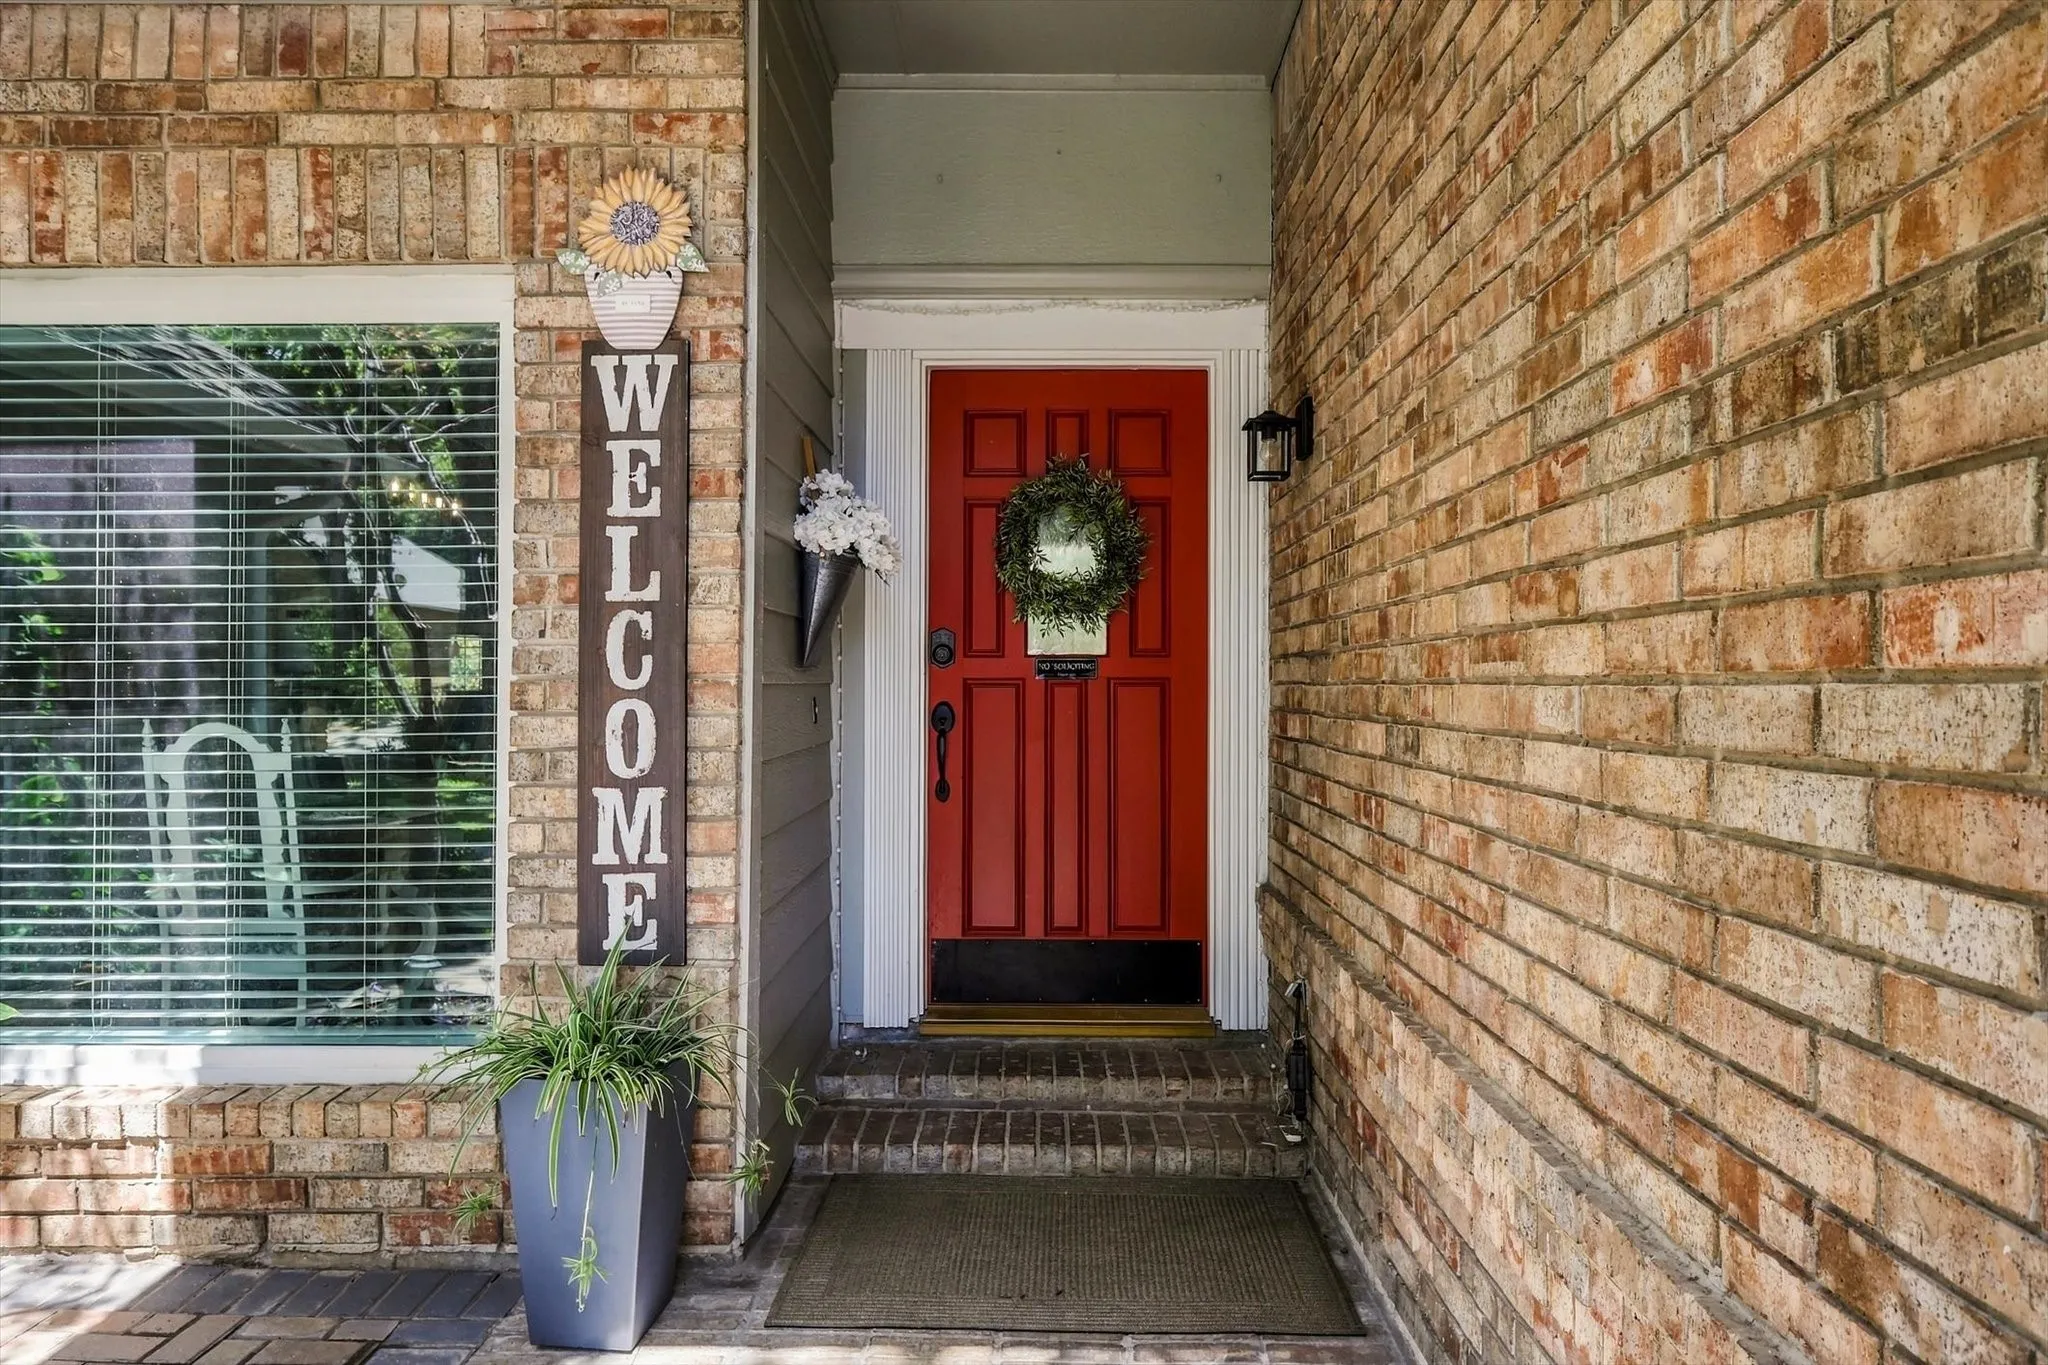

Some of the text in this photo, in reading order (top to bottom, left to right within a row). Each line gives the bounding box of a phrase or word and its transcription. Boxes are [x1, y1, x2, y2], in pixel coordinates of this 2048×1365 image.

[590, 354, 678, 951] WELCOME
[1039, 662, 1095, 670] NO SOLICITING
